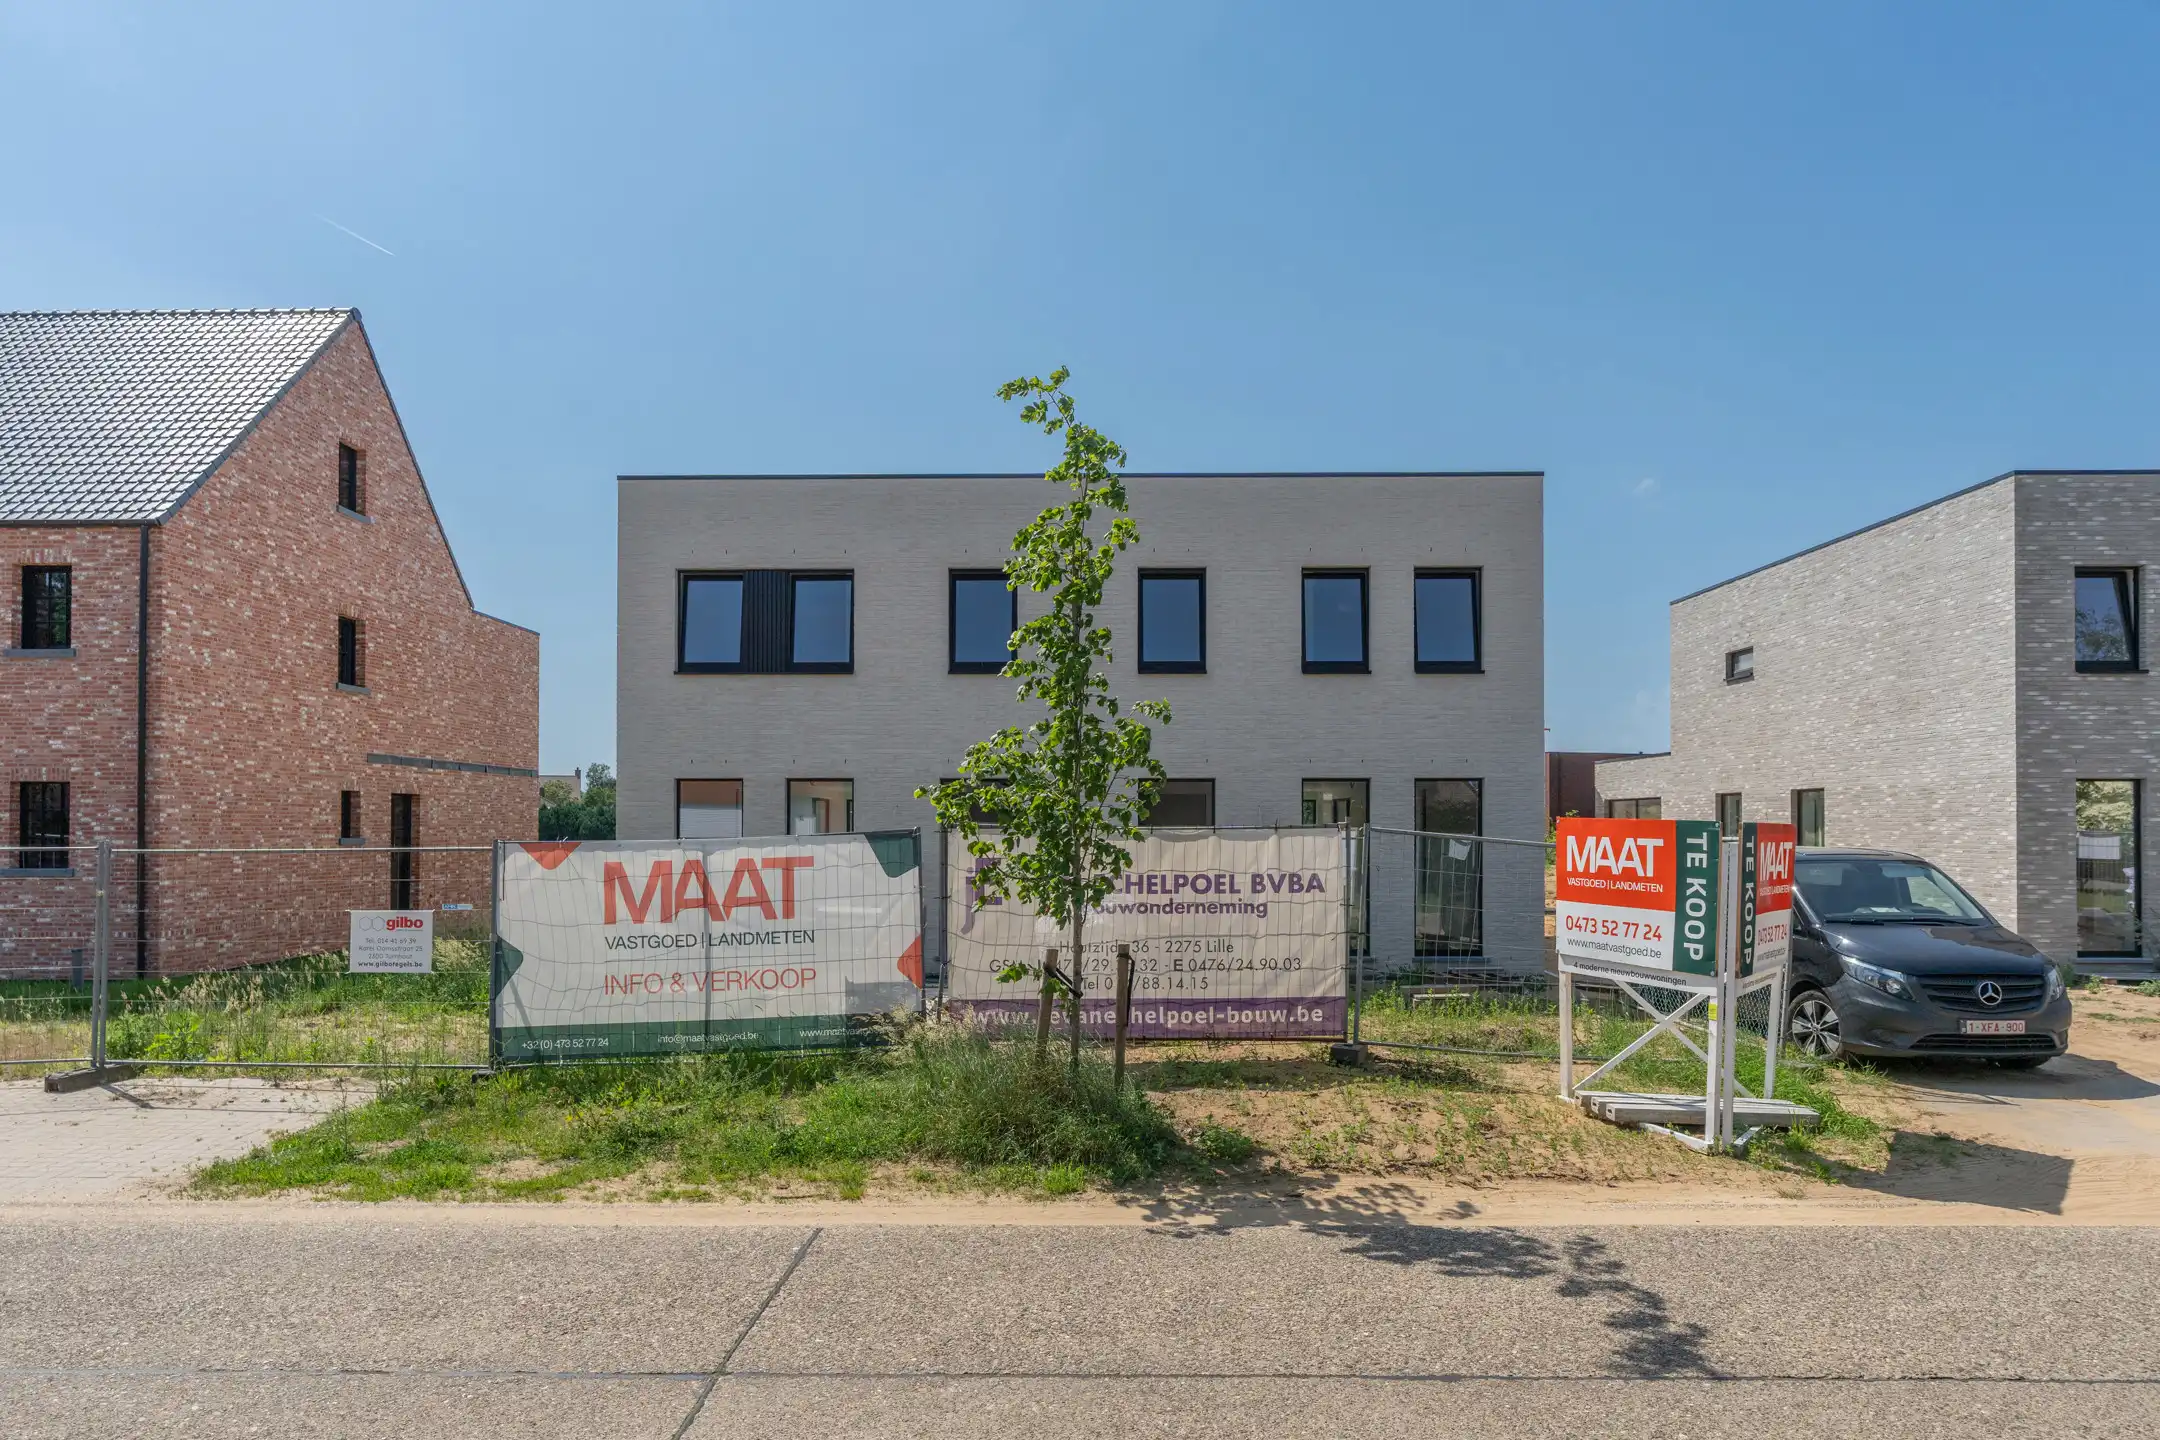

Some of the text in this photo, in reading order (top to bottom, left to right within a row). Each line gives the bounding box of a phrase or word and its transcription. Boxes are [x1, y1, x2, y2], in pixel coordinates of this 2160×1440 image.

[1566, 835, 1664, 877] MAAT
[1760, 842, 1793, 880] MAAT
[603, 855, 815, 925] MAAT
[1251, 873, 1326, 894] BVBA
[1566, 877, 1664, 894] VASTGOED LANDMETEN
[1683, 831, 1708, 961] TE KOOP
[1744, 836, 1754, 965] TE KOOP
[1094, 898, 1268, 918] ouwonderneming
[386, 916, 424, 931] gilbo
[1565, 915, 1663, 942] 0473 52 77 24
[605, 929, 815, 950] VASTGOED LANDMETEN
[1132, 940, 1150, 953] 36
[1165, 940, 1202, 953] 2275
[1207, 939, 1234, 953] Lille
[1566, 938, 1662, 959] www.maatvastgoed.be
[1173, 959, 1184, 971] E
[1188, 957, 1301, 972] 0476/24.90.03
[1580, 961, 1610, 974] moderne
[1610, 968, 1687, 986] nieuwbouwwoningen
[604, 968, 817, 995] INFO & VERKOOP
[1104, 975, 1209, 991] 0/88.14.15
[1968, 1022, 2024, 1032] 1-XFA-900
[540, 1039, 553, 1050] (0)
[554, 1038, 570, 1049] 473
[572, 1038, 585, 1048] 52
[586, 1038, 597, 1048] 77
[598, 1037, 610, 1047] 24
